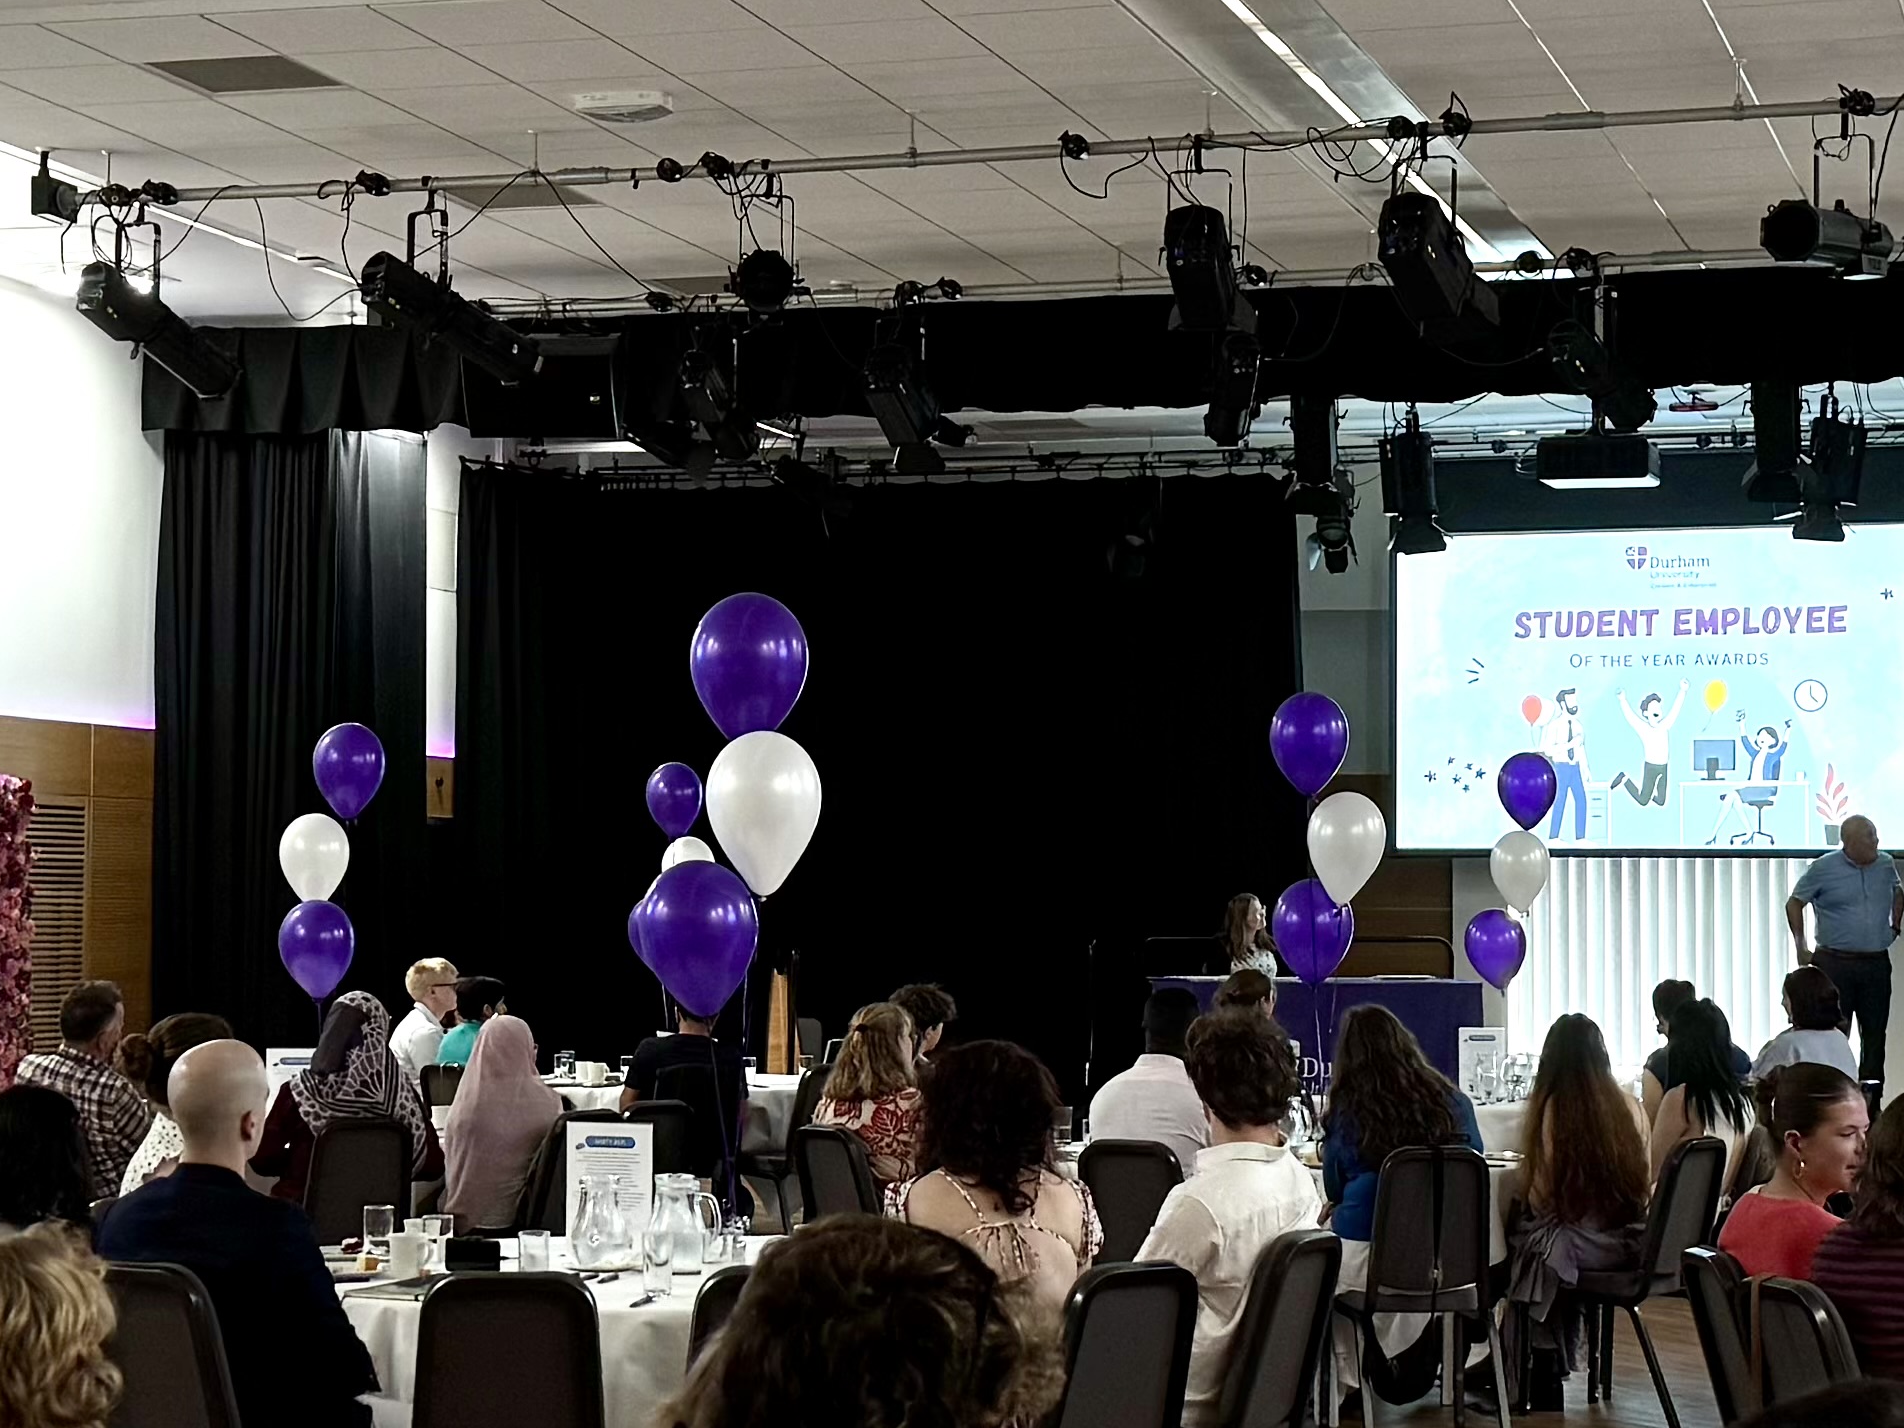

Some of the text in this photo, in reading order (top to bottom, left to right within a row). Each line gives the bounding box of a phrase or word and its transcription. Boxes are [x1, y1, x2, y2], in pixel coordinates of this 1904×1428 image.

[1650, 555, 1710, 569] Durham
[1514, 605, 1848, 639] STUDENT EMPLOYEE
[1570, 651, 1770, 668] OF THE YEAR AWARDS
